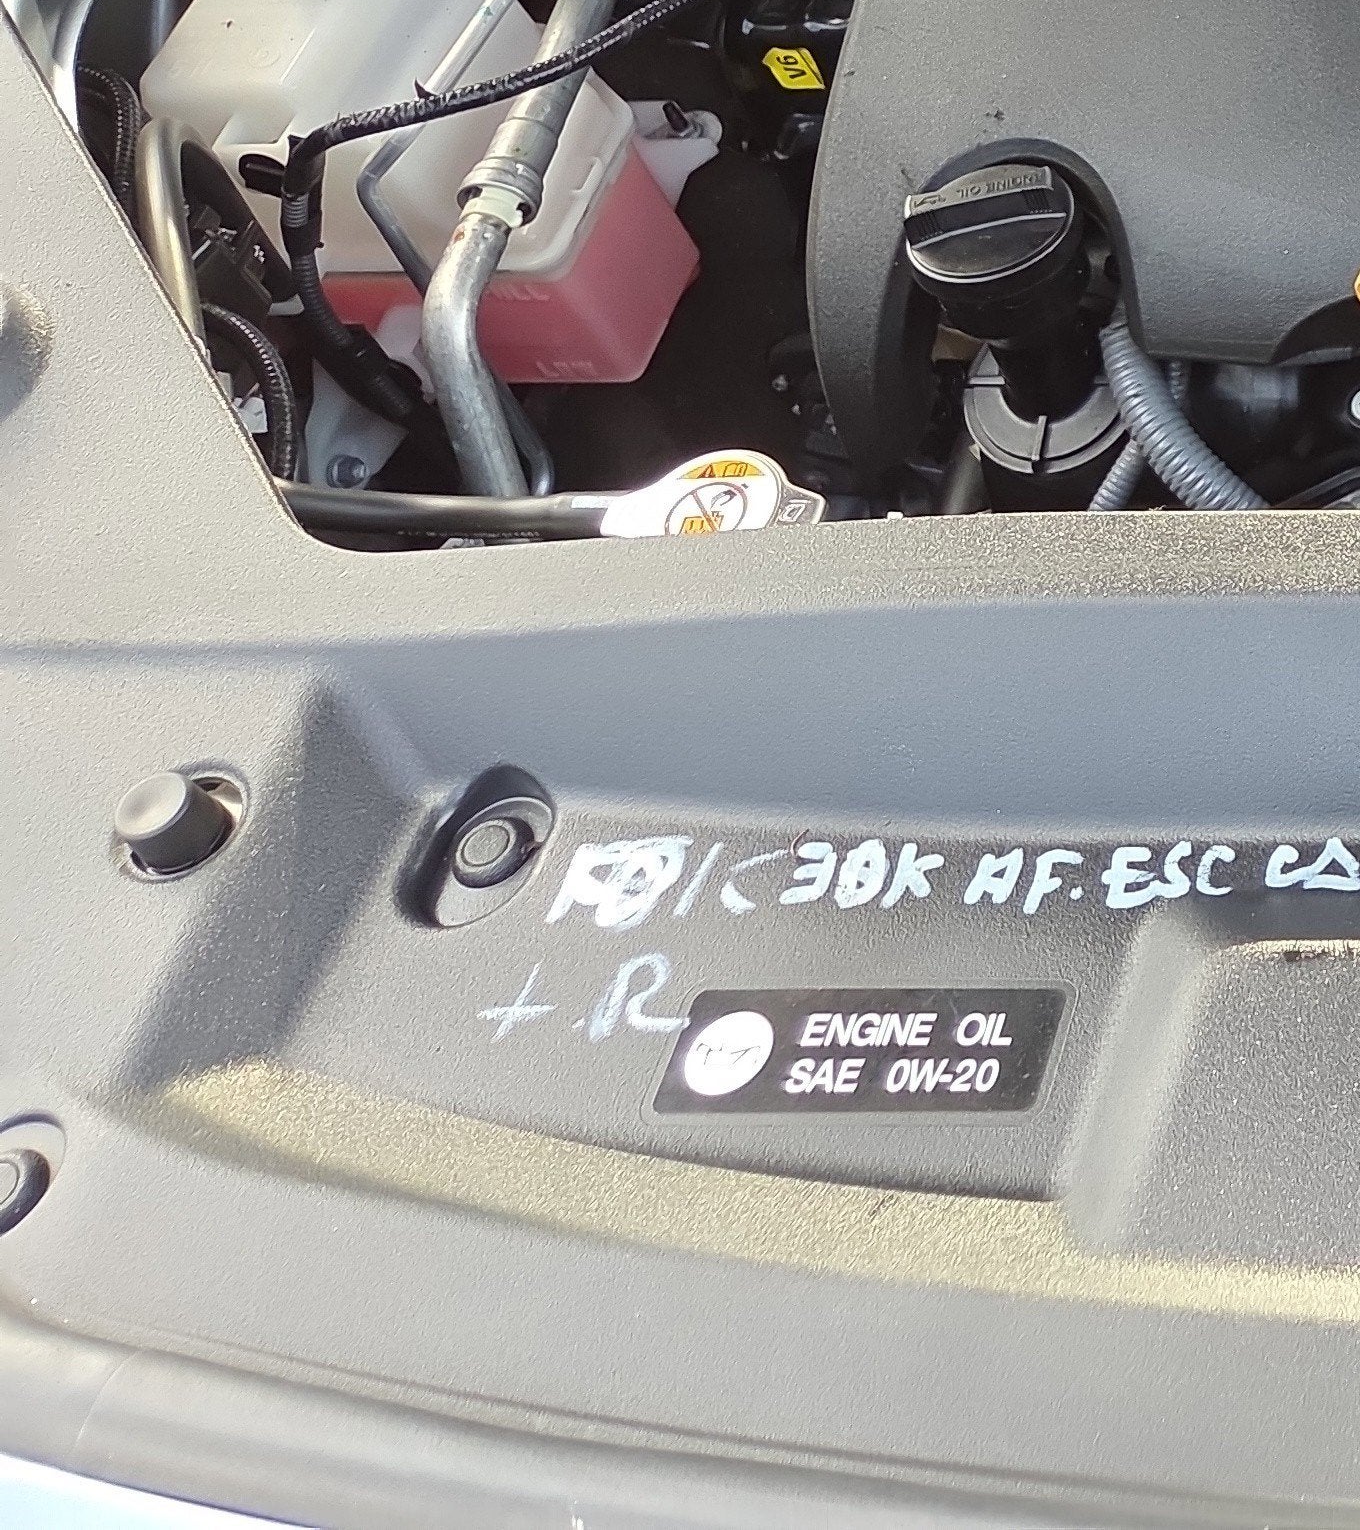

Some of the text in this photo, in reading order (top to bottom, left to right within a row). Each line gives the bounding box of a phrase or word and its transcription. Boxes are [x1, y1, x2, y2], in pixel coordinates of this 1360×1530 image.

[800, 1012, 1013, 1047] ENGINE OIL
[785, 1058, 1000, 1094] SAE 0W-20
